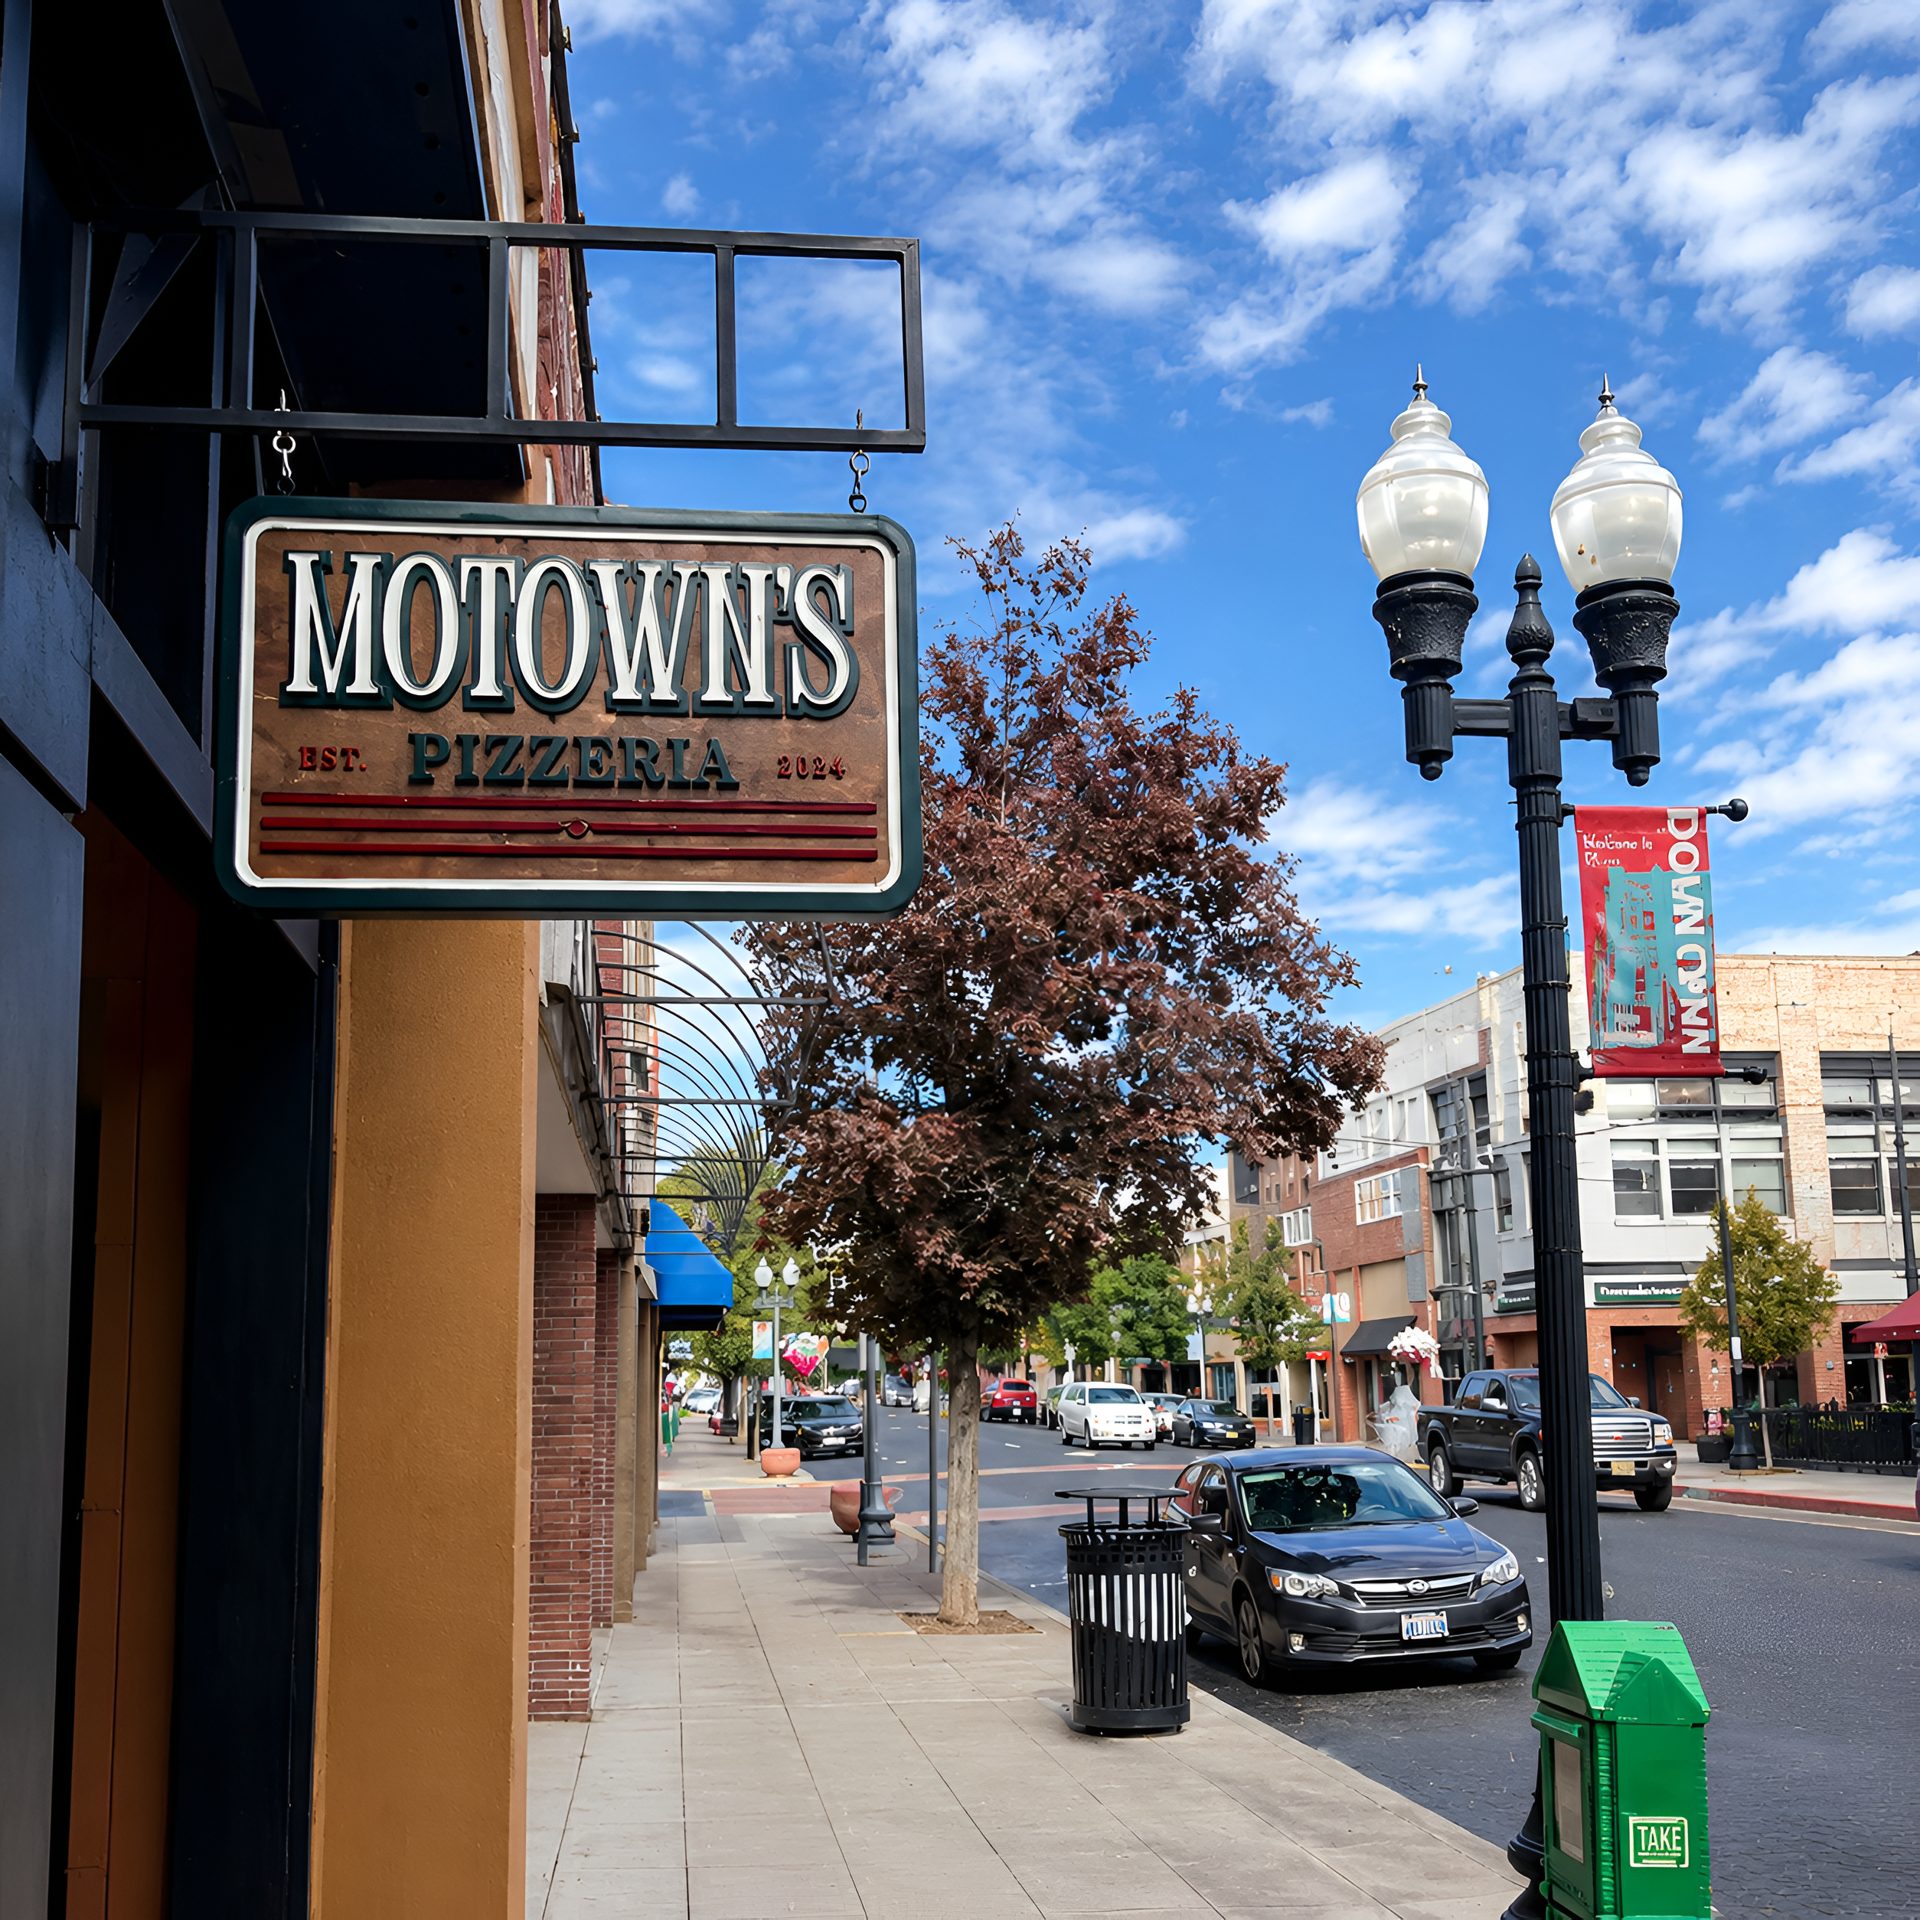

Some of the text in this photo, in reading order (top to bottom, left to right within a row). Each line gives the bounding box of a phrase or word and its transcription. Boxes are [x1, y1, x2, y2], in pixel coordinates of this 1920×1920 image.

[281, 550, 858, 718] MOTOWN'S
[299, 745, 368, 772] EST.
[407, 732, 741, 791] PIZZERIA
[777, 753, 846, 780] 2024
[1636, 1825, 1682, 1852] TAKE
